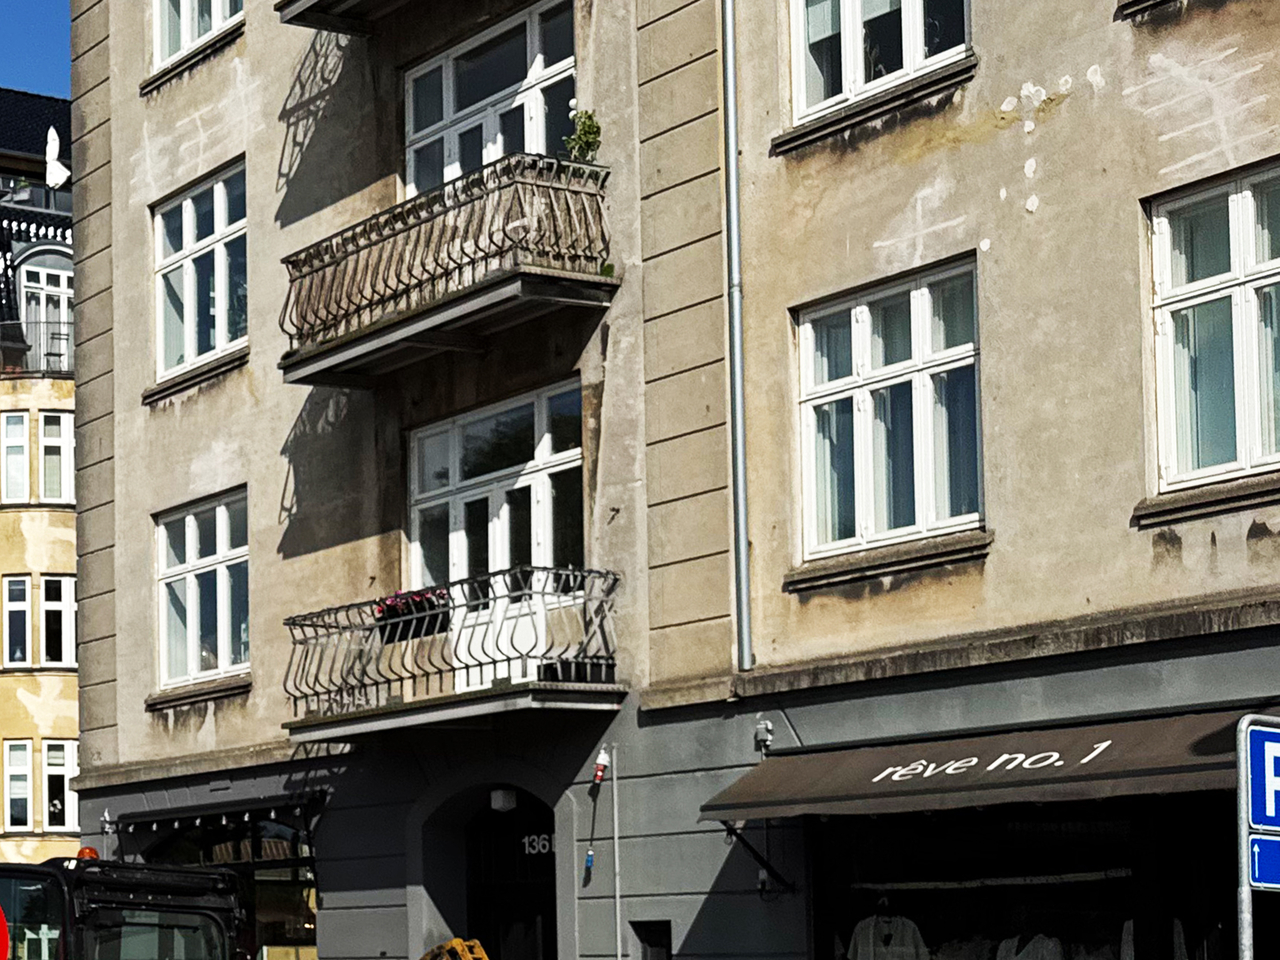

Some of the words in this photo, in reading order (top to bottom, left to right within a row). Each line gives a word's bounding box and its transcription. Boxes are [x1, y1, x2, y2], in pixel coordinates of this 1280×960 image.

[871, 755, 979, 783] rêve
[986, 750, 1064, 771] no.
[1079, 739, 1113, 765] 1
[522, 834, 550, 854] 136
